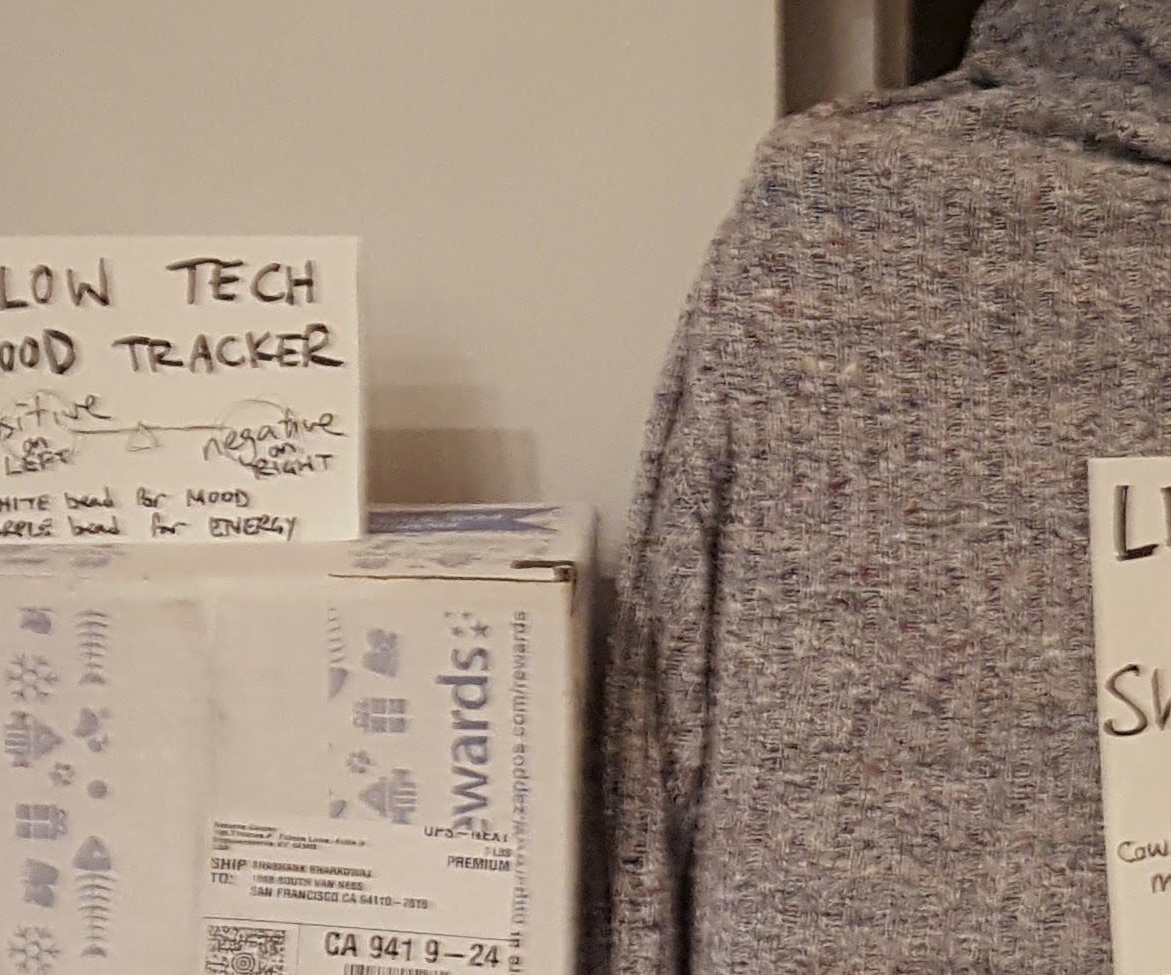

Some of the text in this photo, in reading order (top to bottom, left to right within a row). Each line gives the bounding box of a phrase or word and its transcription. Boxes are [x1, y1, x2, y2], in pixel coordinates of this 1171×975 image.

[166, 257, 316, 306] TECH
[111, 323, 344, 373] TRACKER
[202, 408, 348, 461] negative
[64, 487, 115, 509] bead
[135, 486, 168, 508] for
[186, 488, 251, 508] MOOD
[71, 516, 121, 537] bead
[151, 512, 187, 537] for
[208, 516, 299, 542] ENERGY
[210, 857, 247, 871] SHIP
[447, 855, 511, 872] PREMIUM
[211, 872, 234, 885] TO:
[250, 886, 273, 897] SAN
[276, 888, 339, 902] FRANCISCO
[342, 893, 357, 904] CA
[324, 931, 500, 969] CA 941 9-24
